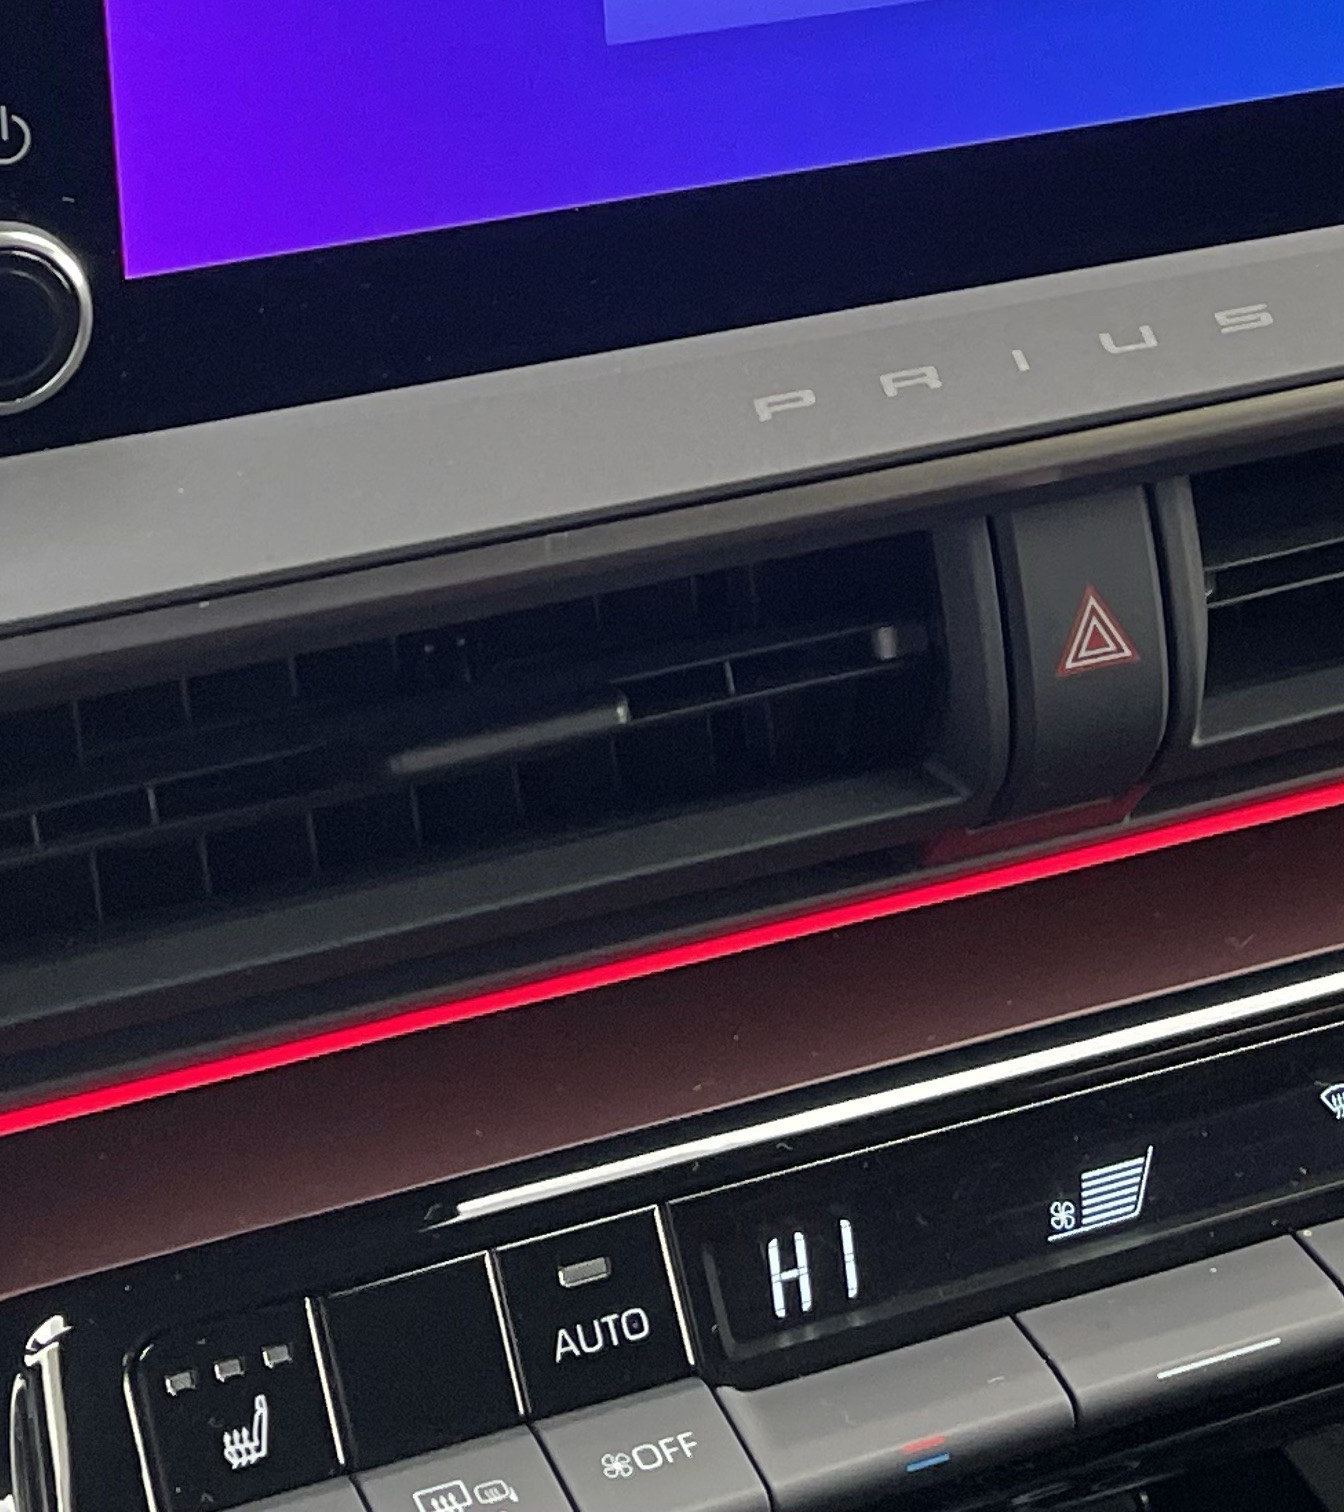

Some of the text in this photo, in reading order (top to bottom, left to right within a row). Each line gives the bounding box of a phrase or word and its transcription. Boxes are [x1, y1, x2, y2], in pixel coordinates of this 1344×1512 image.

[753, 303, 1275, 424] PRIUS
[554, 1306, 651, 1364] AUTO
[631, 1430, 699, 1471] OFF
